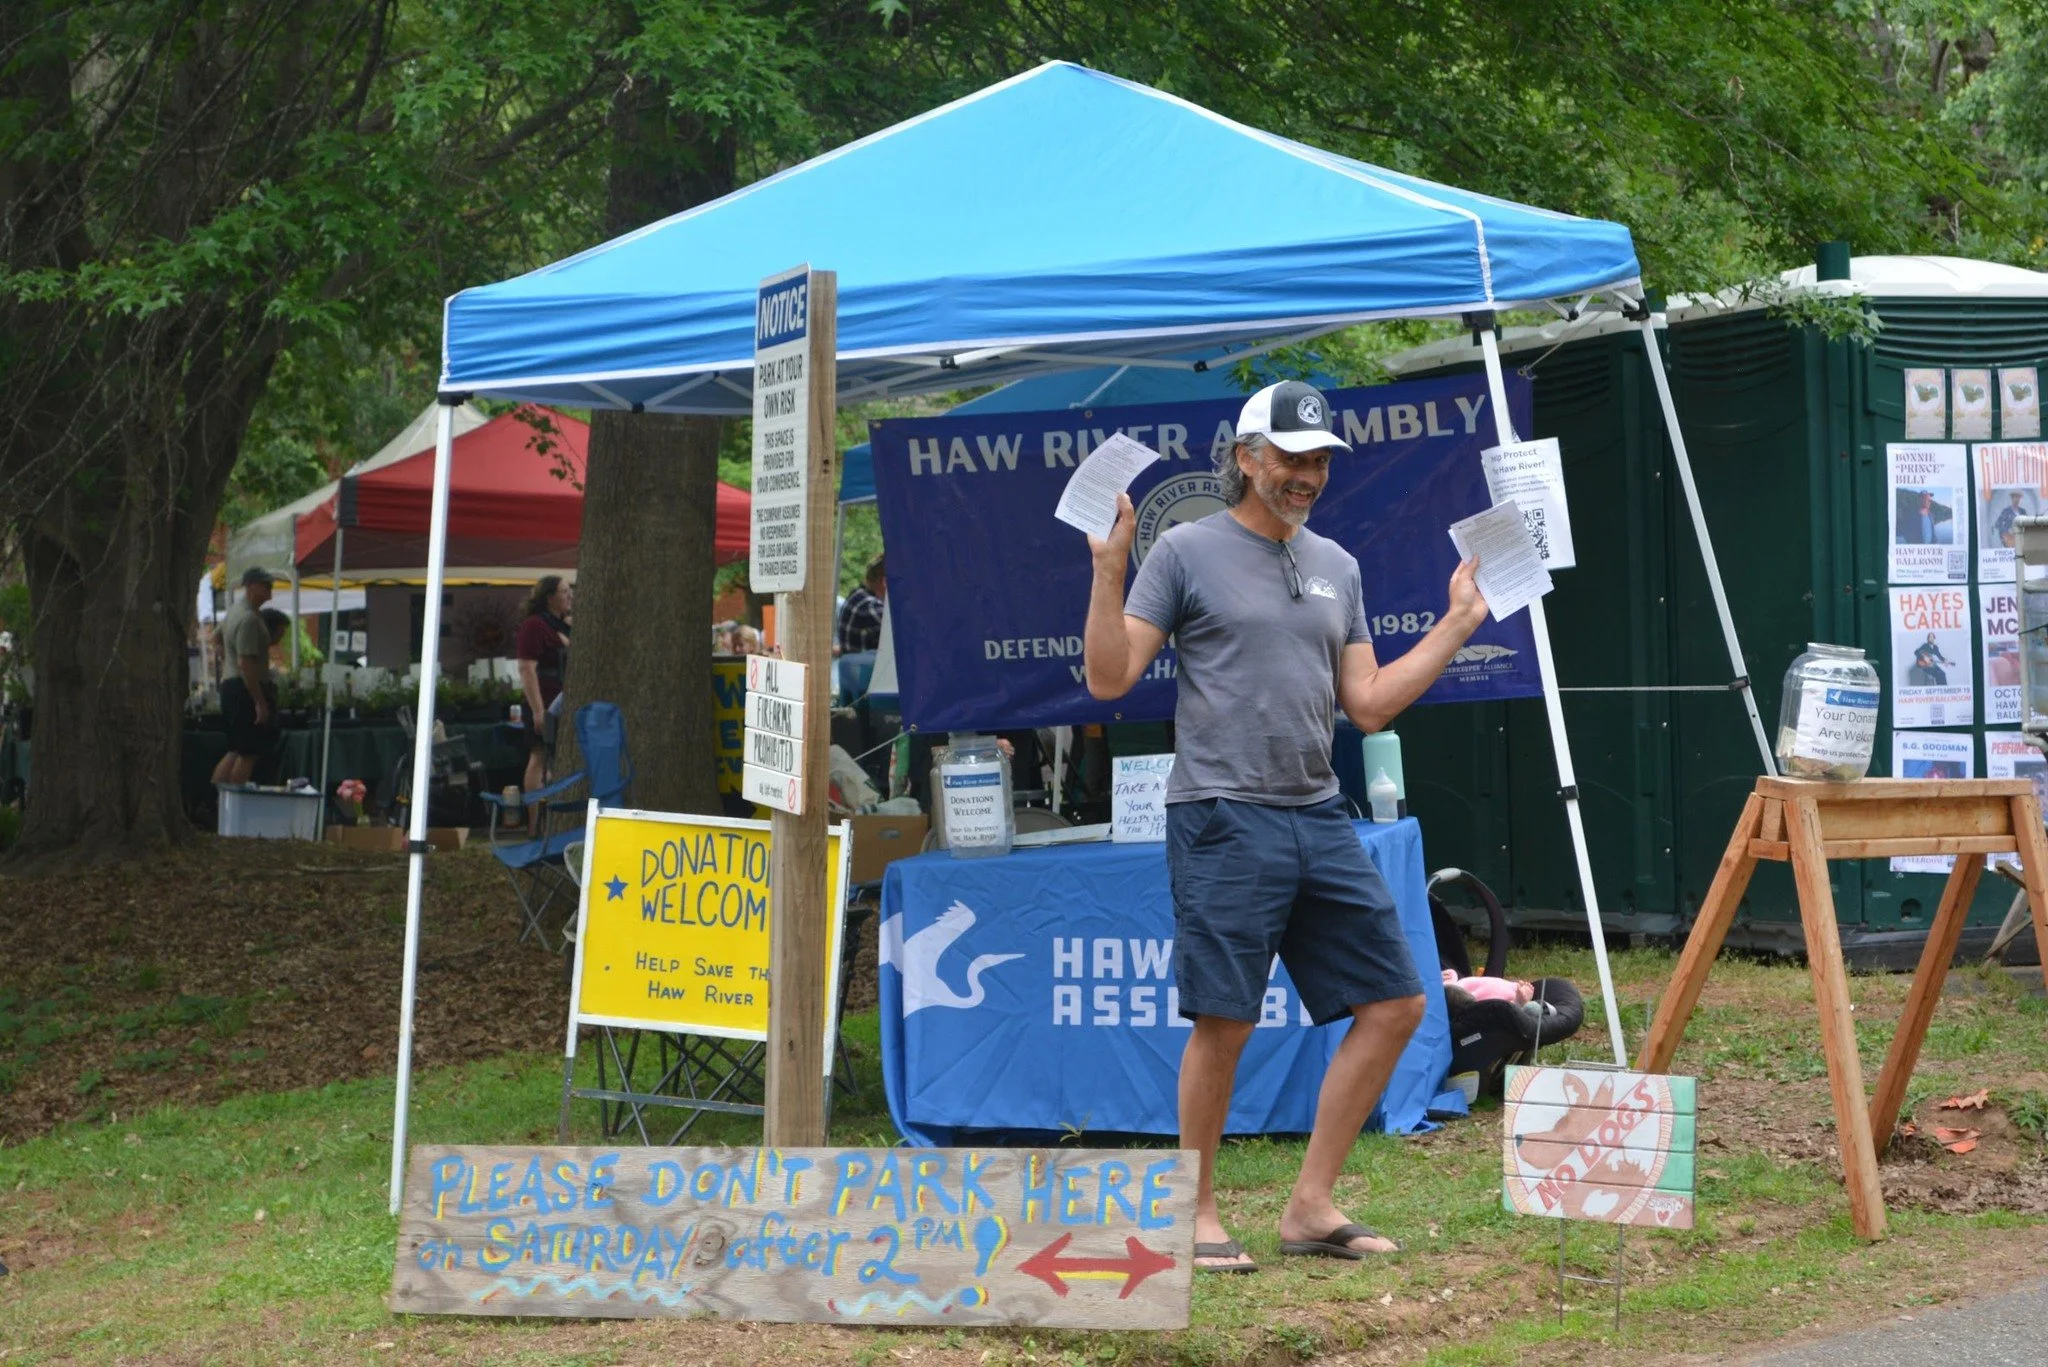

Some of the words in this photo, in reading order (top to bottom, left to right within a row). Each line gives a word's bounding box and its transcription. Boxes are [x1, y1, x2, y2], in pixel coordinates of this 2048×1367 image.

[760, 284, 806, 340] NOTICE
[759, 361, 775, 389] PARK
[777, 358, 785, 384] AT
[786, 354, 802, 381] YOUR
[764, 393, 779, 419] OWN
[780, 388, 796, 415] RISK
[764, 432, 774, 448] THIS
[775, 430, 789, 447] SPACE
[790, 429, 795, 446] IS
[908, 433, 1023, 476] HAW
[1210, 394, 1486, 456] AMBLY
[763, 452, 784, 471] PROVIDED
[786, 450, 795, 468] FOR
[1503, 448, 1537, 460] Protect
[1895, 452, 1936, 463] BONNIE
[756, 475, 769, 495] YOUR
[769, 471, 800, 492] CONVENIENCE
[1895, 475, 1927, 485] BILLY
[763, 507, 782, 522] COMPANY
[782, 504, 800, 519] ASSUMES
[1140, 508, 1158, 540] HAW
[1156, 482, 1197, 508] RIVER
[760, 526, 766, 541] NO
[766, 523, 796, 540] RESPONSIBILITY
[758, 545, 766, 558] FOR
[766, 543, 775, 558] LOSS
[776, 542, 782, 557] OR
[782, 541, 798, 556] DAMAGE
[1895, 548, 1916, 556] HAW
[1917, 548, 1944, 556] RIVER
[759, 562, 764, 576] TO
[764, 561, 779, 576] PARKED
[780, 560, 797, 575] VEHICLES
[1895, 557, 1943, 566] BALLROOM
[1900, 592, 1964, 612] HAYES
[1903, 611, 1962, 630] CARLL
[1987, 619, 2019, 636] MC
[984, 636, 1084, 660] DEFEND
[1372, 611, 1436, 636] 1982
[766, 661, 779, 693] ALL
[1815, 708, 1845, 721] Your
[1996, 701, 2018, 709] HAW
[757, 696, 792, 736] FIREARMS
[1818, 727, 1841, 740] Are
[1845, 730, 1874, 742] Welco
[754, 734, 793, 772] PROHIBITED
[1812, 747, 1828, 756] Help
[1902, 743, 1920, 751] S.G.
[1922, 743, 1968, 752] GOODMAN
[1115, 782, 1148, 795] TAKE
[1152, 782, 1160, 791] A
[950, 795, 994, 805] DONATIONS
[1125, 800, 1154, 814] YOUR
[953, 807, 992, 816] WELCOME
[641, 833, 770, 888] DONATIO
[641, 881, 766, 932] WELCOM
[635, 952, 680, 972] HELP
[694, 957, 733, 978] SAVE
[749, 966, 770, 981] TH
[1053, 938, 1174, 979] HAW
[648, 980, 685, 1000] HAW
[705, 985, 753, 1006] RIVER
[1536, 1163, 1577, 1210] NO
[1577, 1079, 1654, 1171] DOGS
[430, 1152, 621, 1220] PLEASE
[641, 1148, 814, 1209] DON'T
[828, 1150, 996, 1223] PARK
[1020, 1153, 1179, 1230] HERE
[418, 1237, 462, 1271] on
[477, 1216, 699, 1284] SATURDAY
[724, 1211, 852, 1276] after
